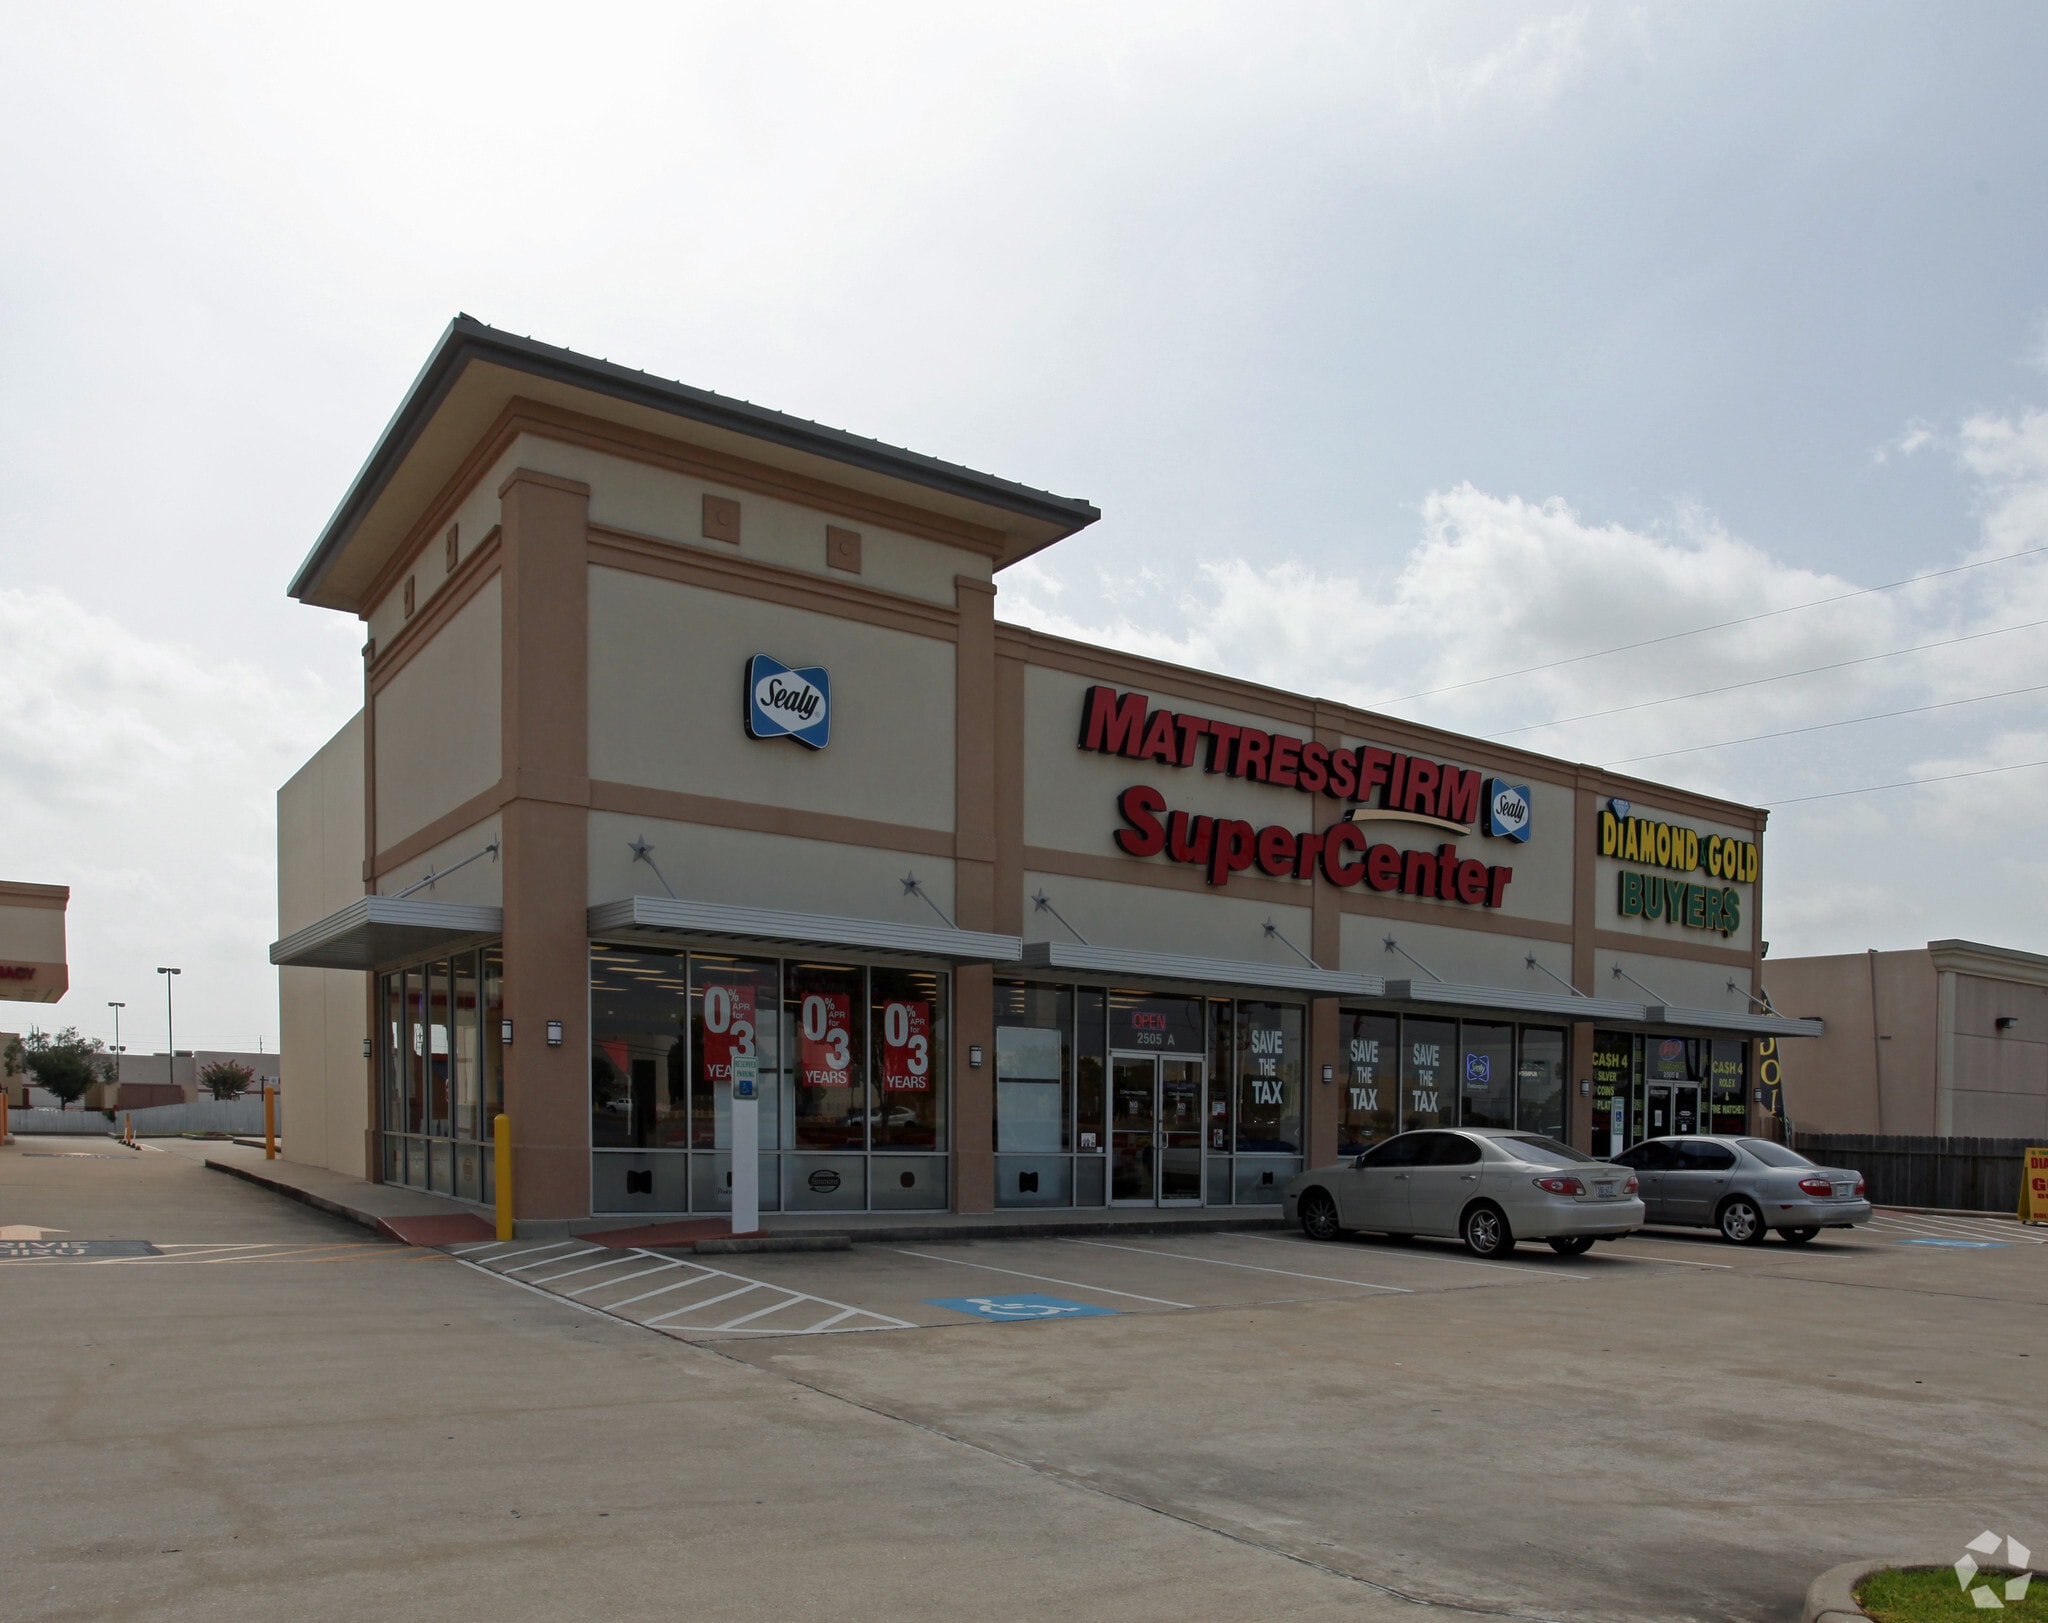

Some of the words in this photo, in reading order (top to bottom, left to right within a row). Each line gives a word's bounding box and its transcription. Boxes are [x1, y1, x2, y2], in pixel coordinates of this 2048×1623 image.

[760, 678, 819, 720] Sealy
[1495, 794, 1526, 824] Sealy
[1113, 785, 1513, 908] SuperCenter
[1707, 834, 1759, 884] GOLD
[732, 1003, 751, 1011] APR
[828, 1011, 845, 1019] APR
[1134, 1013, 1167, 1029] OPEN
[729, 1020, 755, 1057] 3
[1137, 1032, 1162, 1045] 2505
[1167, 1033, 1175, 1046] A
[1251, 1029, 1283, 1054] SAVE
[825, 1027, 851, 1070] 3
[907, 1034, 929, 1075] 3
[1350, 1039, 1379, 1063] SAVE
[1413, 1043, 1440, 1067] SAVE
[707, 1063, 732, 1078] YEA
[1258, 1058, 1276, 1076] THE
[1621, 1054, 1628, 1069] 4
[805, 1070, 848, 1084] YEARS
[886, 1075, 926, 1089] YEARS
[1357, 1066, 1372, 1084] THE
[1419, 1069, 1433, 1087] THE
[1597, 1071, 1617, 1081] SILVER
[1251, 1080, 1283, 1105] TAX
[1350, 1087, 1378, 1111] TAX
[1597, 1085, 1615, 1096] COINS
[1412, 1090, 1439, 1113] TAX
[1597, 1100, 1611, 1111] PLAT
[2031, 1157, 2048, 1169] DIA
